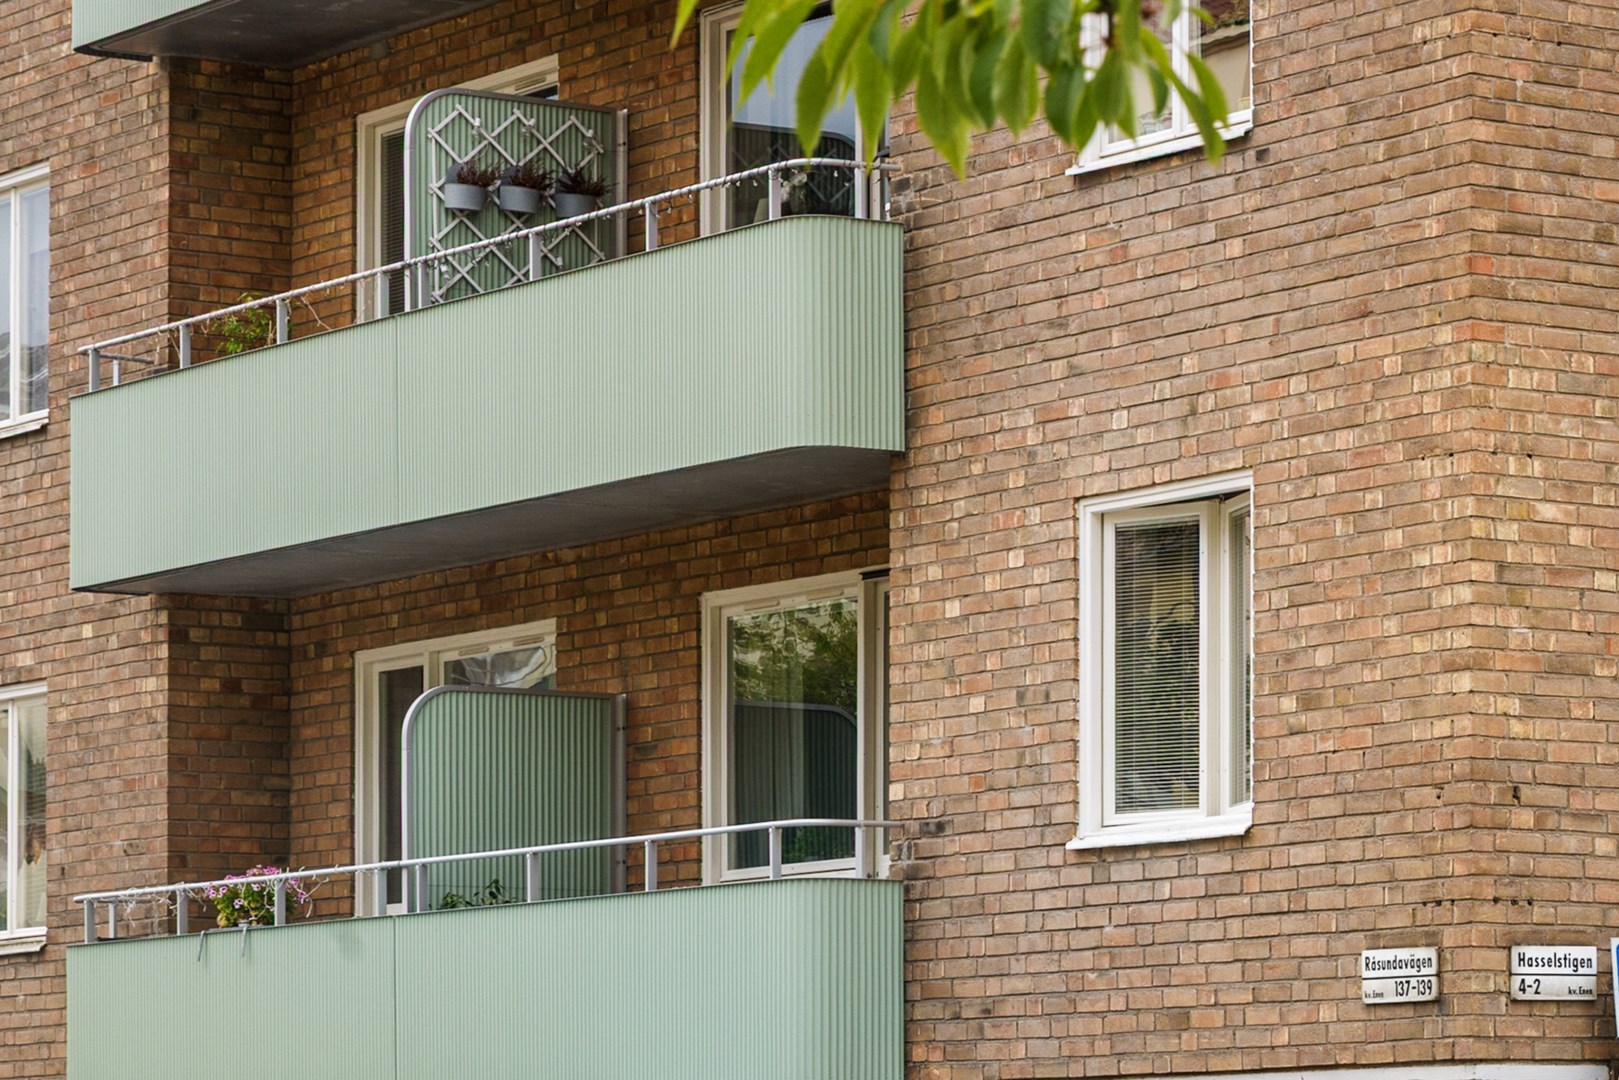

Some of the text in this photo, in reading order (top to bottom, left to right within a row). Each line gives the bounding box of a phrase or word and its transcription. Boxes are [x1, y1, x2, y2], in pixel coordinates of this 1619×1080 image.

[1364, 954, 1433, 973] Råsundavägen
[1517, 952, 1593, 973] Hasselstigen
[1394, 979, 1433, 997] 137-139
[1518, 978, 1542, 995] 4-2
